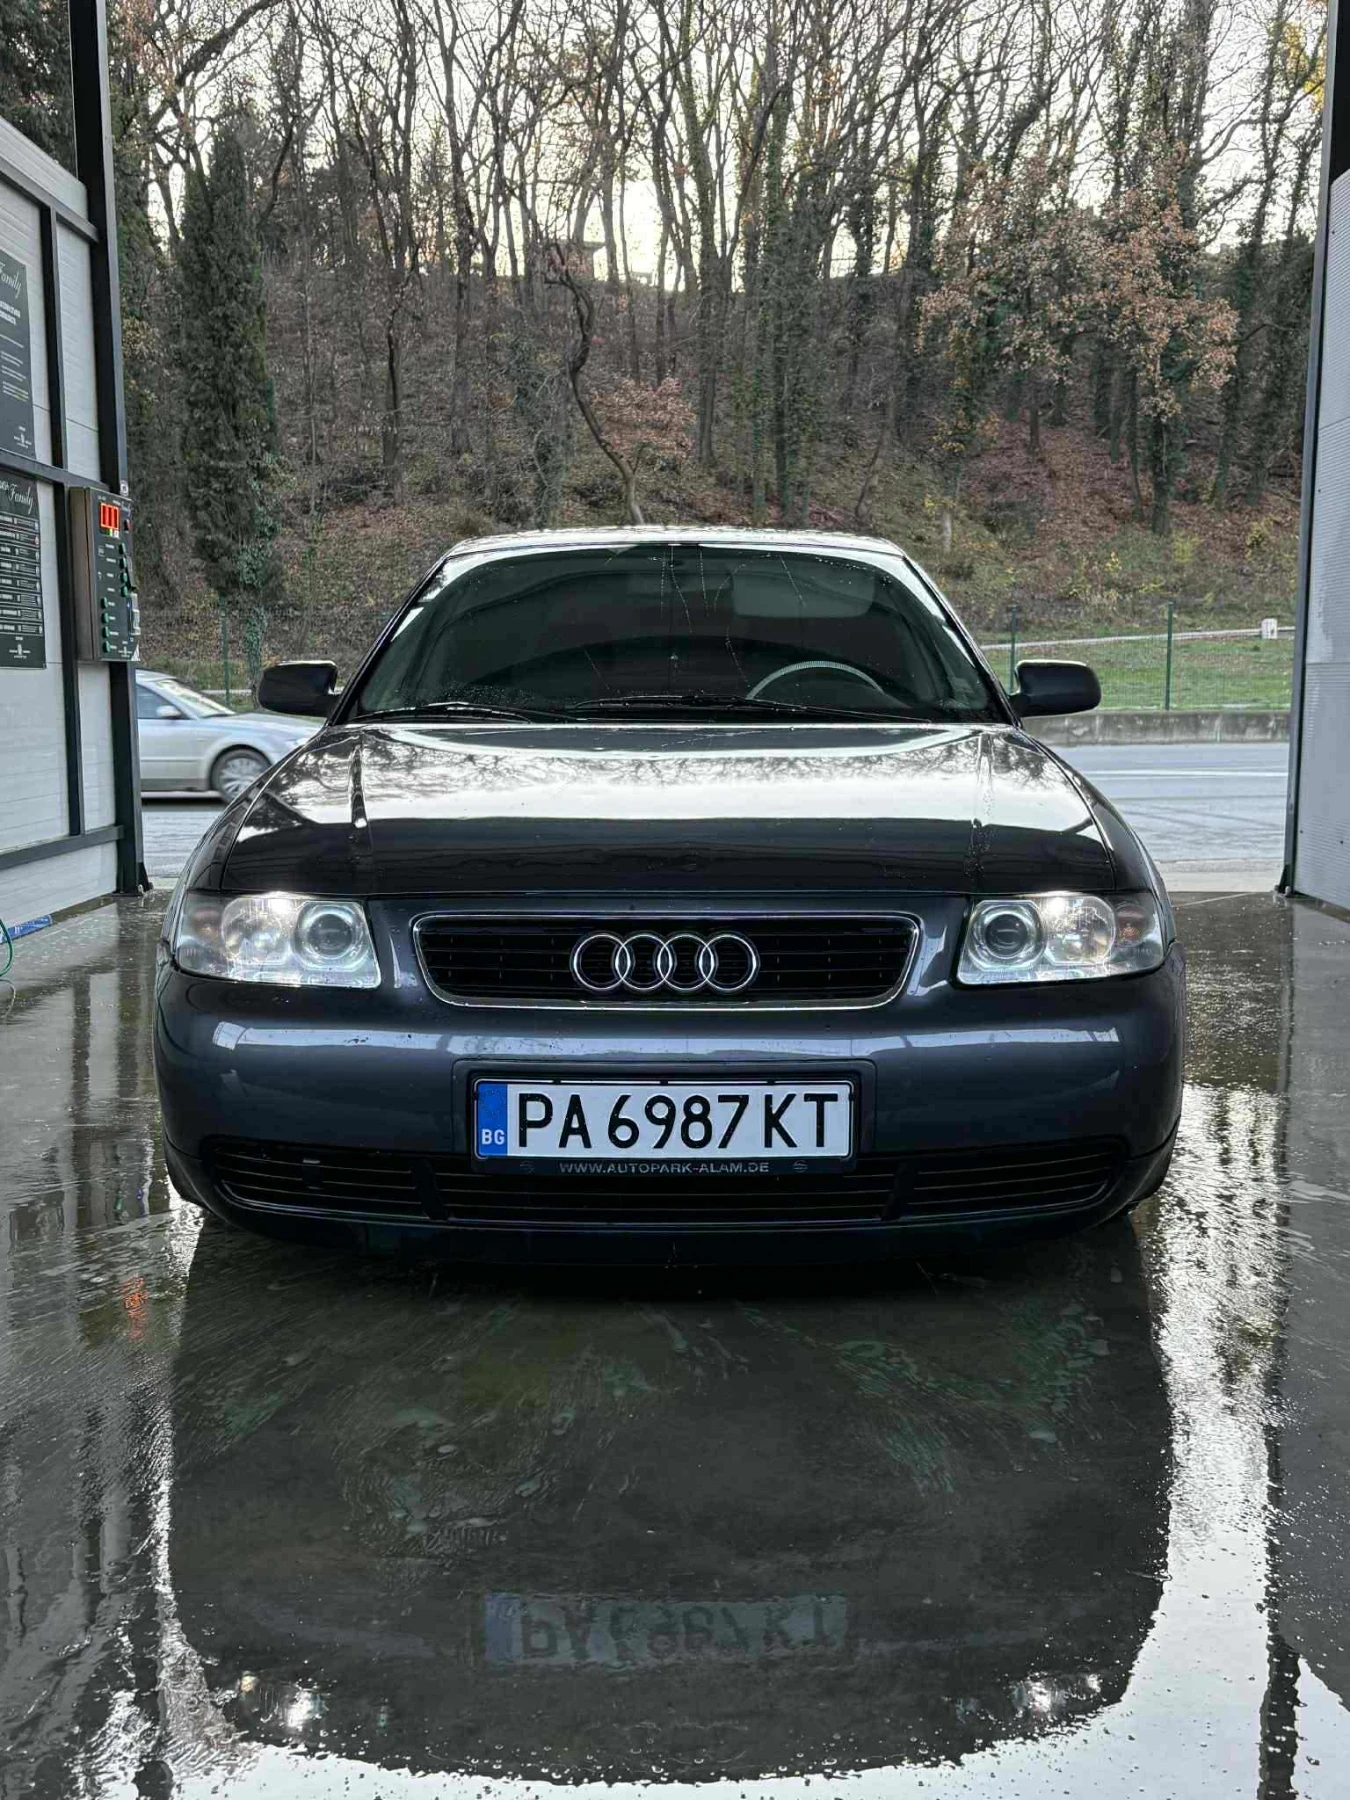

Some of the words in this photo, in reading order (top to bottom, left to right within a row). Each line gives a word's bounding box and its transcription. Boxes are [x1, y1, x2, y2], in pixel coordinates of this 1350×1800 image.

[518, 1093, 592, 1148] PA
[608, 1094, 749, 1149] 6987
[764, 1093, 838, 1149] KT
[481, 1129, 505, 1145] BG
[559, 1161, 770, 1174] WWW.AUTOPARK-ALAM.DE
